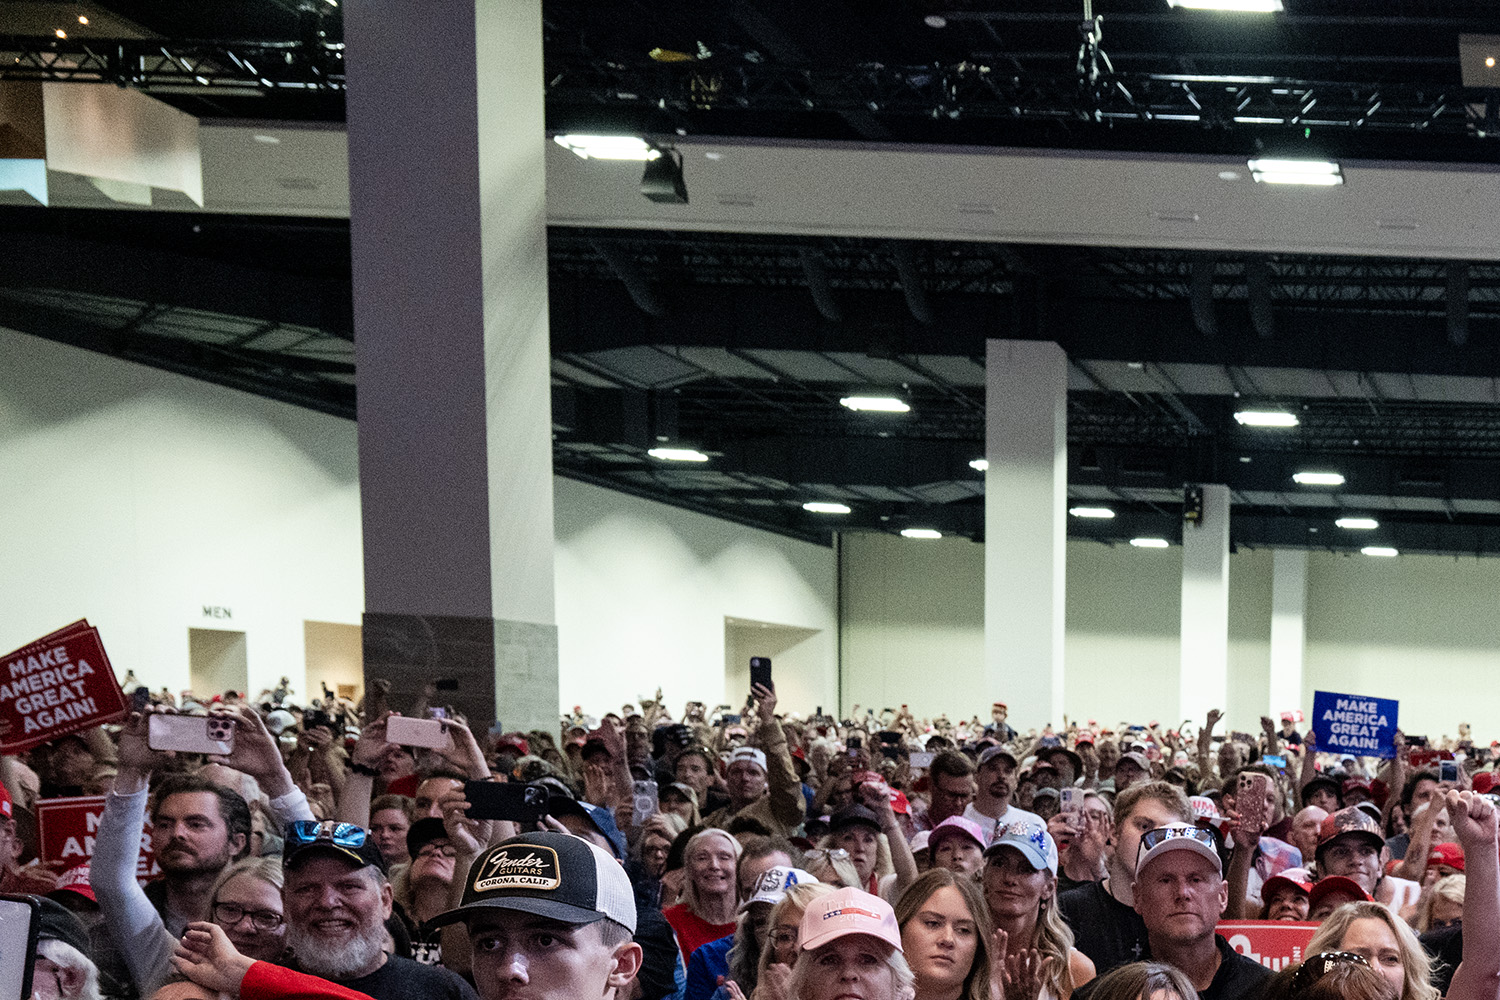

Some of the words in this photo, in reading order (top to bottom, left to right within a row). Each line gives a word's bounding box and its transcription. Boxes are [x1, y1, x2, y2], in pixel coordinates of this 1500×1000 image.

[202, 605, 233, 619] MEN
[8, 646, 70, 680] MAKE
[0, 659, 96, 701] AMERICA
[15, 680, 86, 715] GREAT
[1336, 699, 1378, 714] MAKE
[24, 698, 99, 734] AGAIN!
[1322, 710, 1388, 727] AMERICA
[1330, 722, 1379, 738] GREAT
[1327, 734, 1379, 750] AGAIN!
[489, 850, 550, 877] Fender
[499, 866, 543, 876] GUITARS
